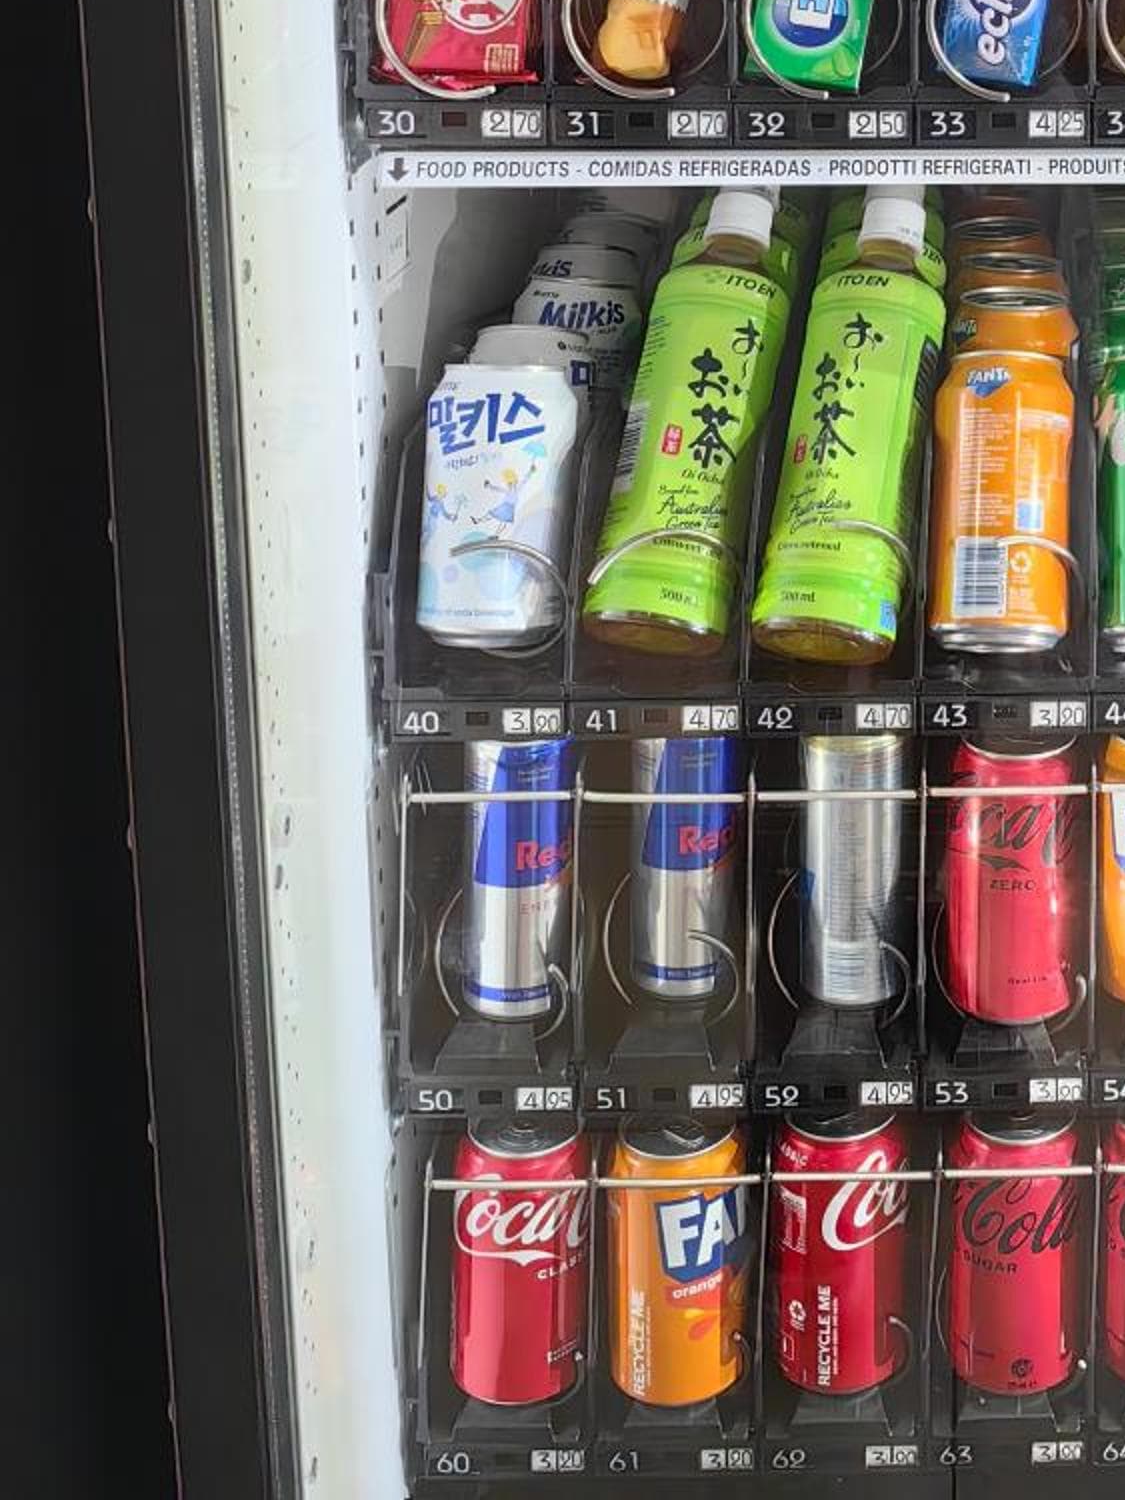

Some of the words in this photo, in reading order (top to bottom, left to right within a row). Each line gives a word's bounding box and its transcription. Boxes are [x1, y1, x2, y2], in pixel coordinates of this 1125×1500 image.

[377, 110, 416, 135] 30
[566, 110, 599, 136] 31
[749, 111, 786, 137] 32
[930, 111, 966, 136] 33
[416, 161, 467, 178] FOOD
[472, 160, 570, 178] PRODUCTS
[588, 159, 672, 177] COMIDAS
[679, 158, 812, 177] REFRIGERADAS
[828, 158, 917, 177] PRODOTTI
[922, 157, 1031, 176] REFRIGERATI
[537, 300, 625, 328] Milkis
[687, 347, 741, 469] お茶
[811, 351, 857, 465] お茶
[428, 390, 546, 455] 밀키스
[403, 711, 440, 734] 40
[585, 709, 617, 732] 41
[757, 707, 793, 730] 42
[932, 705, 967, 727] 43
[989, 879, 1037, 892] ZERO
[418, 1089, 453, 1112] 50
[596, 1087, 626, 1109] 51
[764, 1085, 799, 1107] 52
[935, 1081, 969, 1104] 53
[961, 1249, 1018, 1274] SUGAR
[816, 1285, 832, 1311] ME
[816, 1314, 832, 1387] RECYCLE
[436, 1452, 470, 1475] 60
[608, 1452, 640, 1472] 61
[772, 1447, 805, 1469] 62
[940, 1445, 973, 1466] 63
